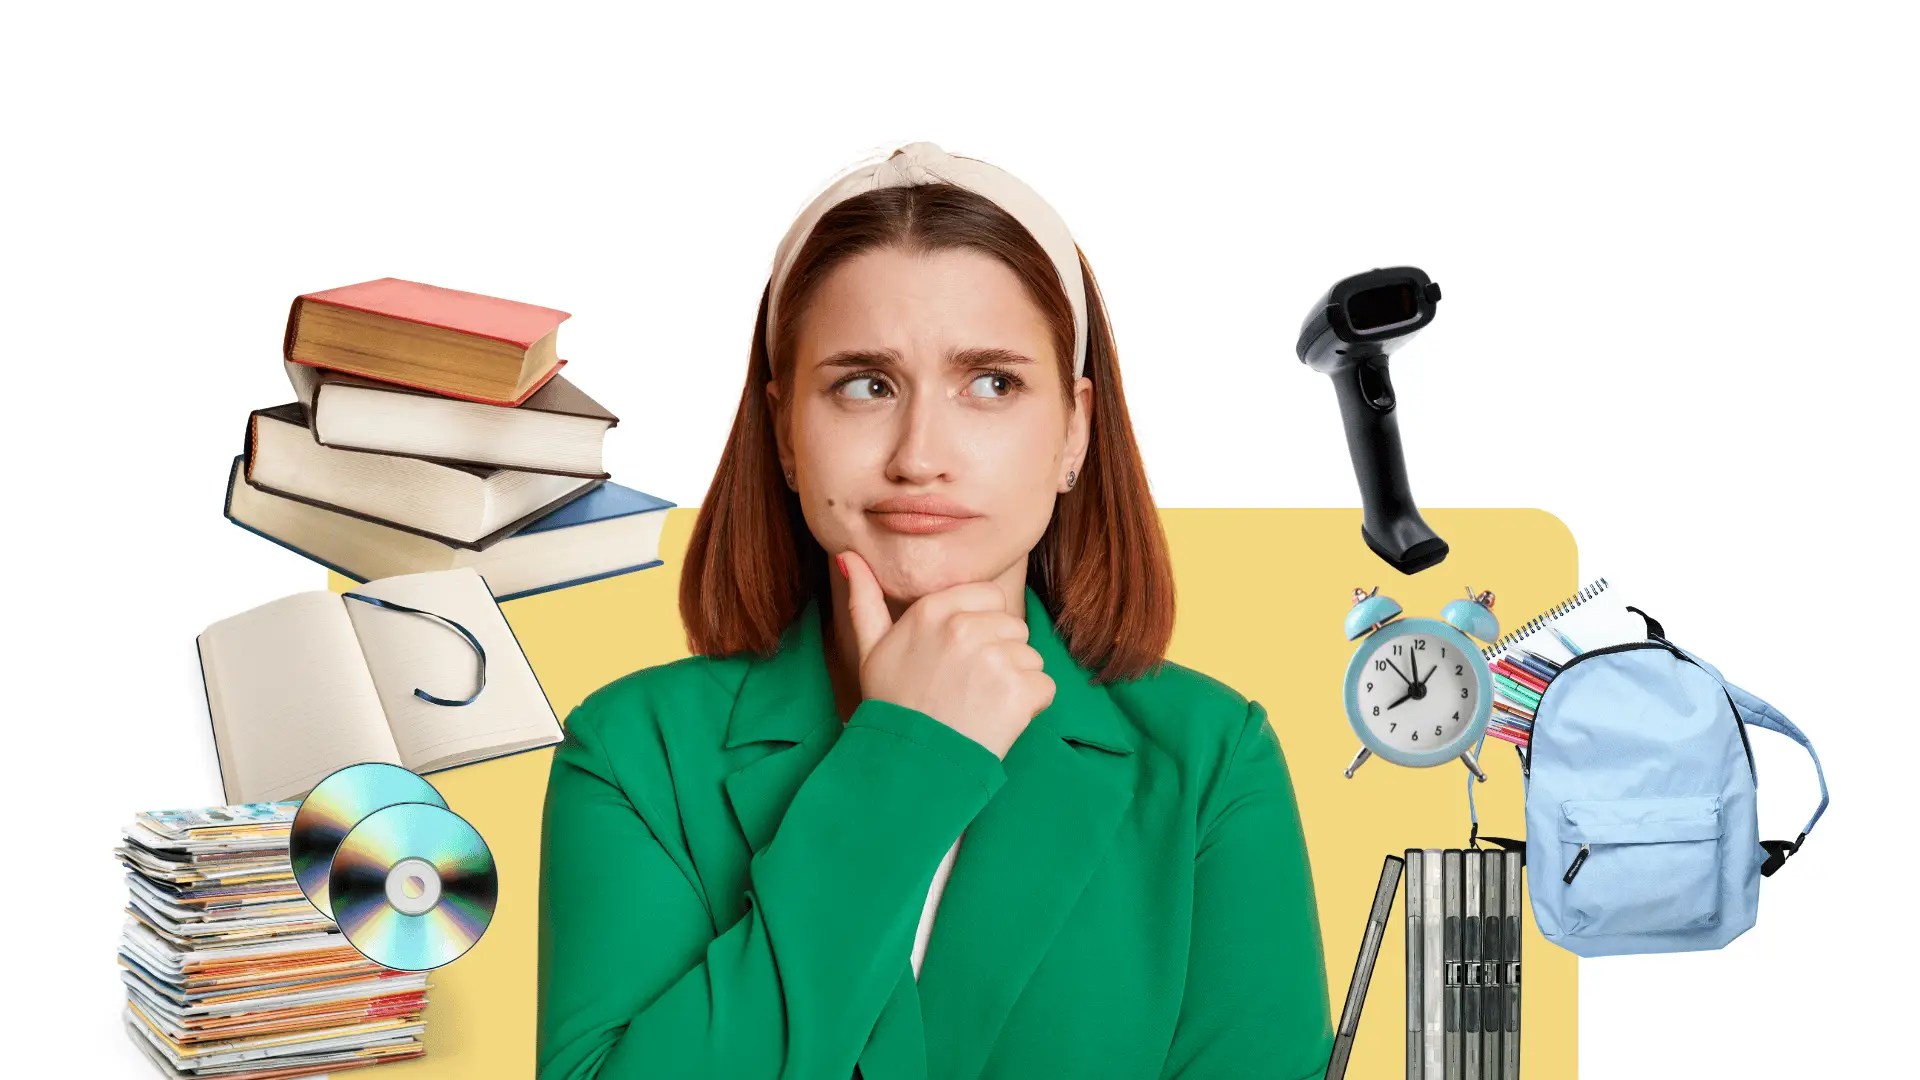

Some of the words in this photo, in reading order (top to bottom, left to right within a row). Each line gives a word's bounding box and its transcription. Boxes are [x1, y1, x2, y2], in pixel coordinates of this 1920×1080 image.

[1392, 645, 1403, 656] 11
[1414, 639, 1426, 651] 12
[1375, 660, 1386, 671] 10
[1455, 664, 1463, 676] 2
[1366, 682, 1374, 693] 9
[1460, 687, 1469, 699] 3
[1372, 705, 1380, 717] 8
[1451, 711, 1460, 722] 4
[1389, 722, 1397, 733] 7
[1434, 725, 1442, 737] 5
[1411, 730, 1419, 741] 6
